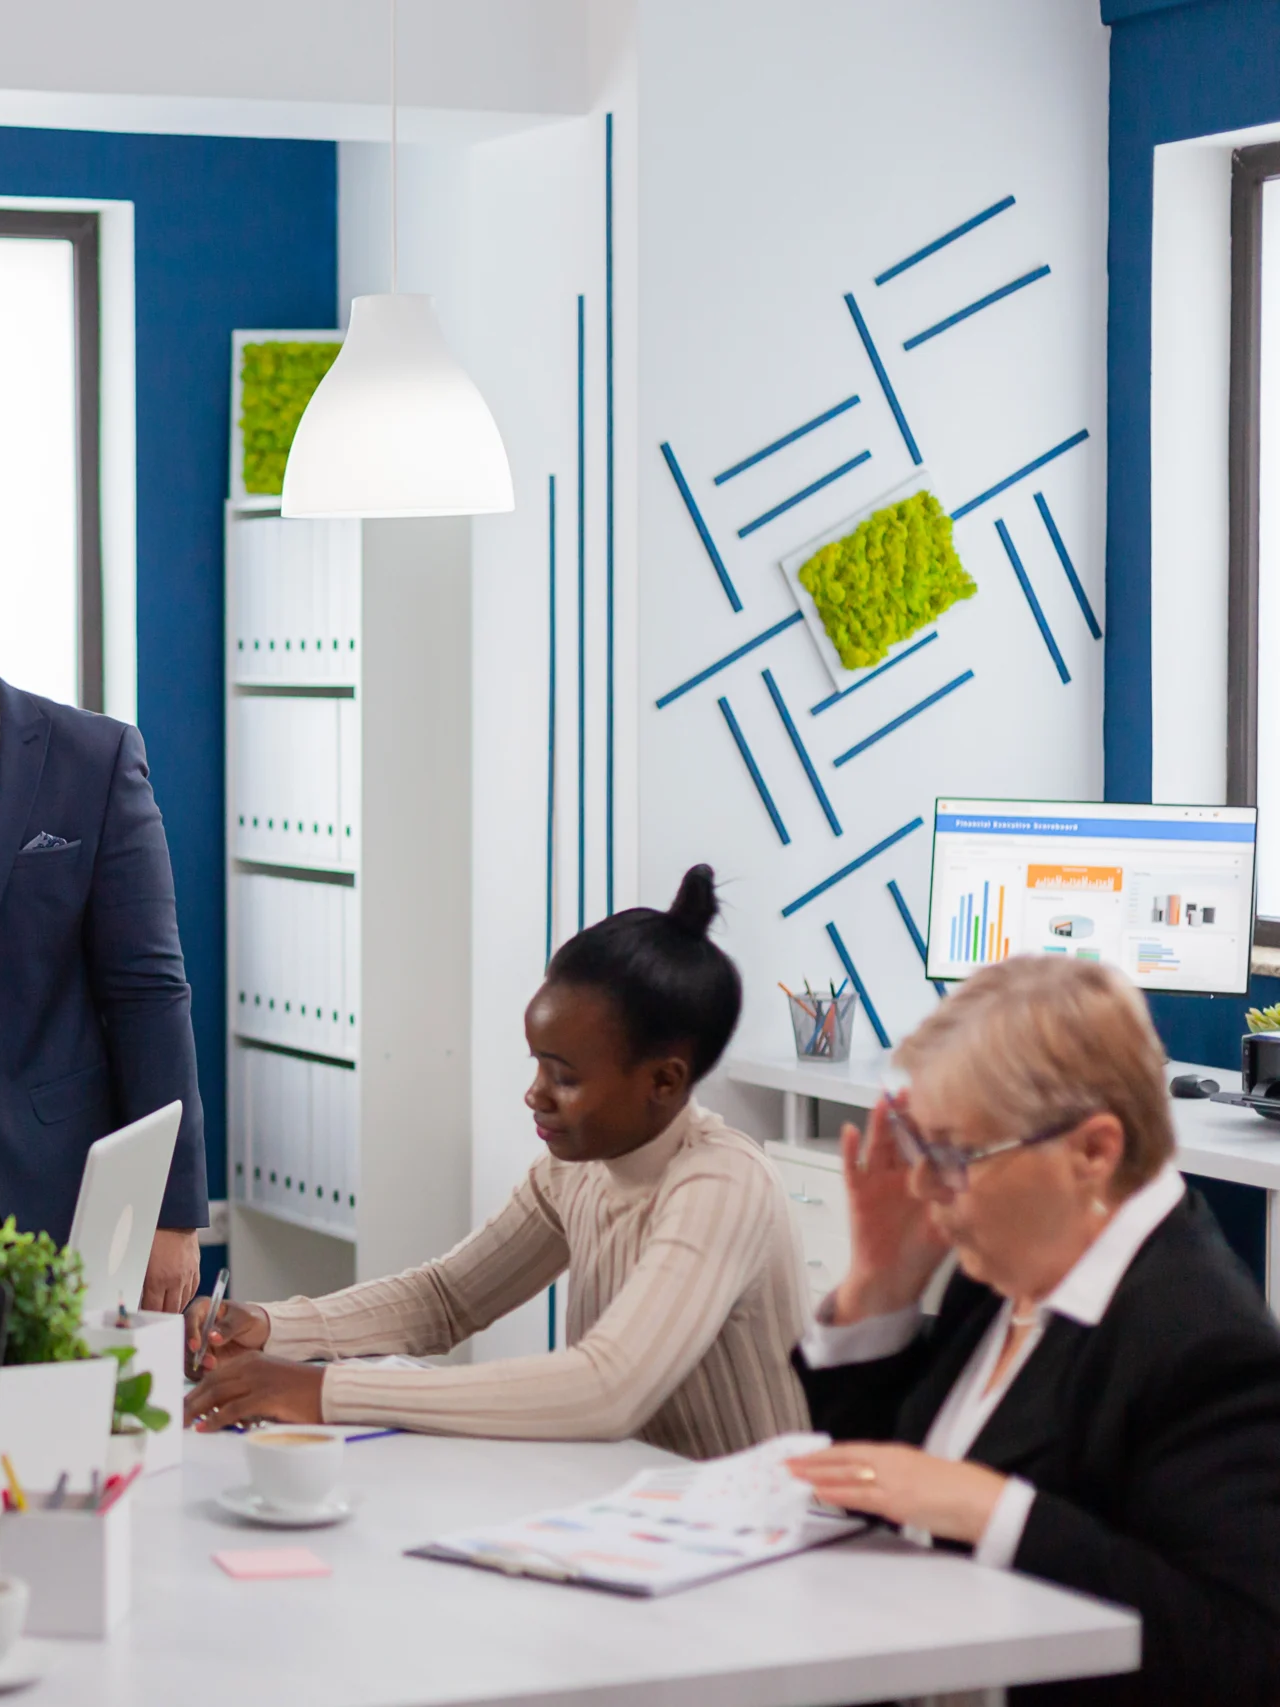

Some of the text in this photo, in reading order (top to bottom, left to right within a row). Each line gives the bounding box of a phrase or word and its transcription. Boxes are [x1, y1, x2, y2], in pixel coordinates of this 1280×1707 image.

[955, 819, 1078, 832] Financial Executive Scoreboard
